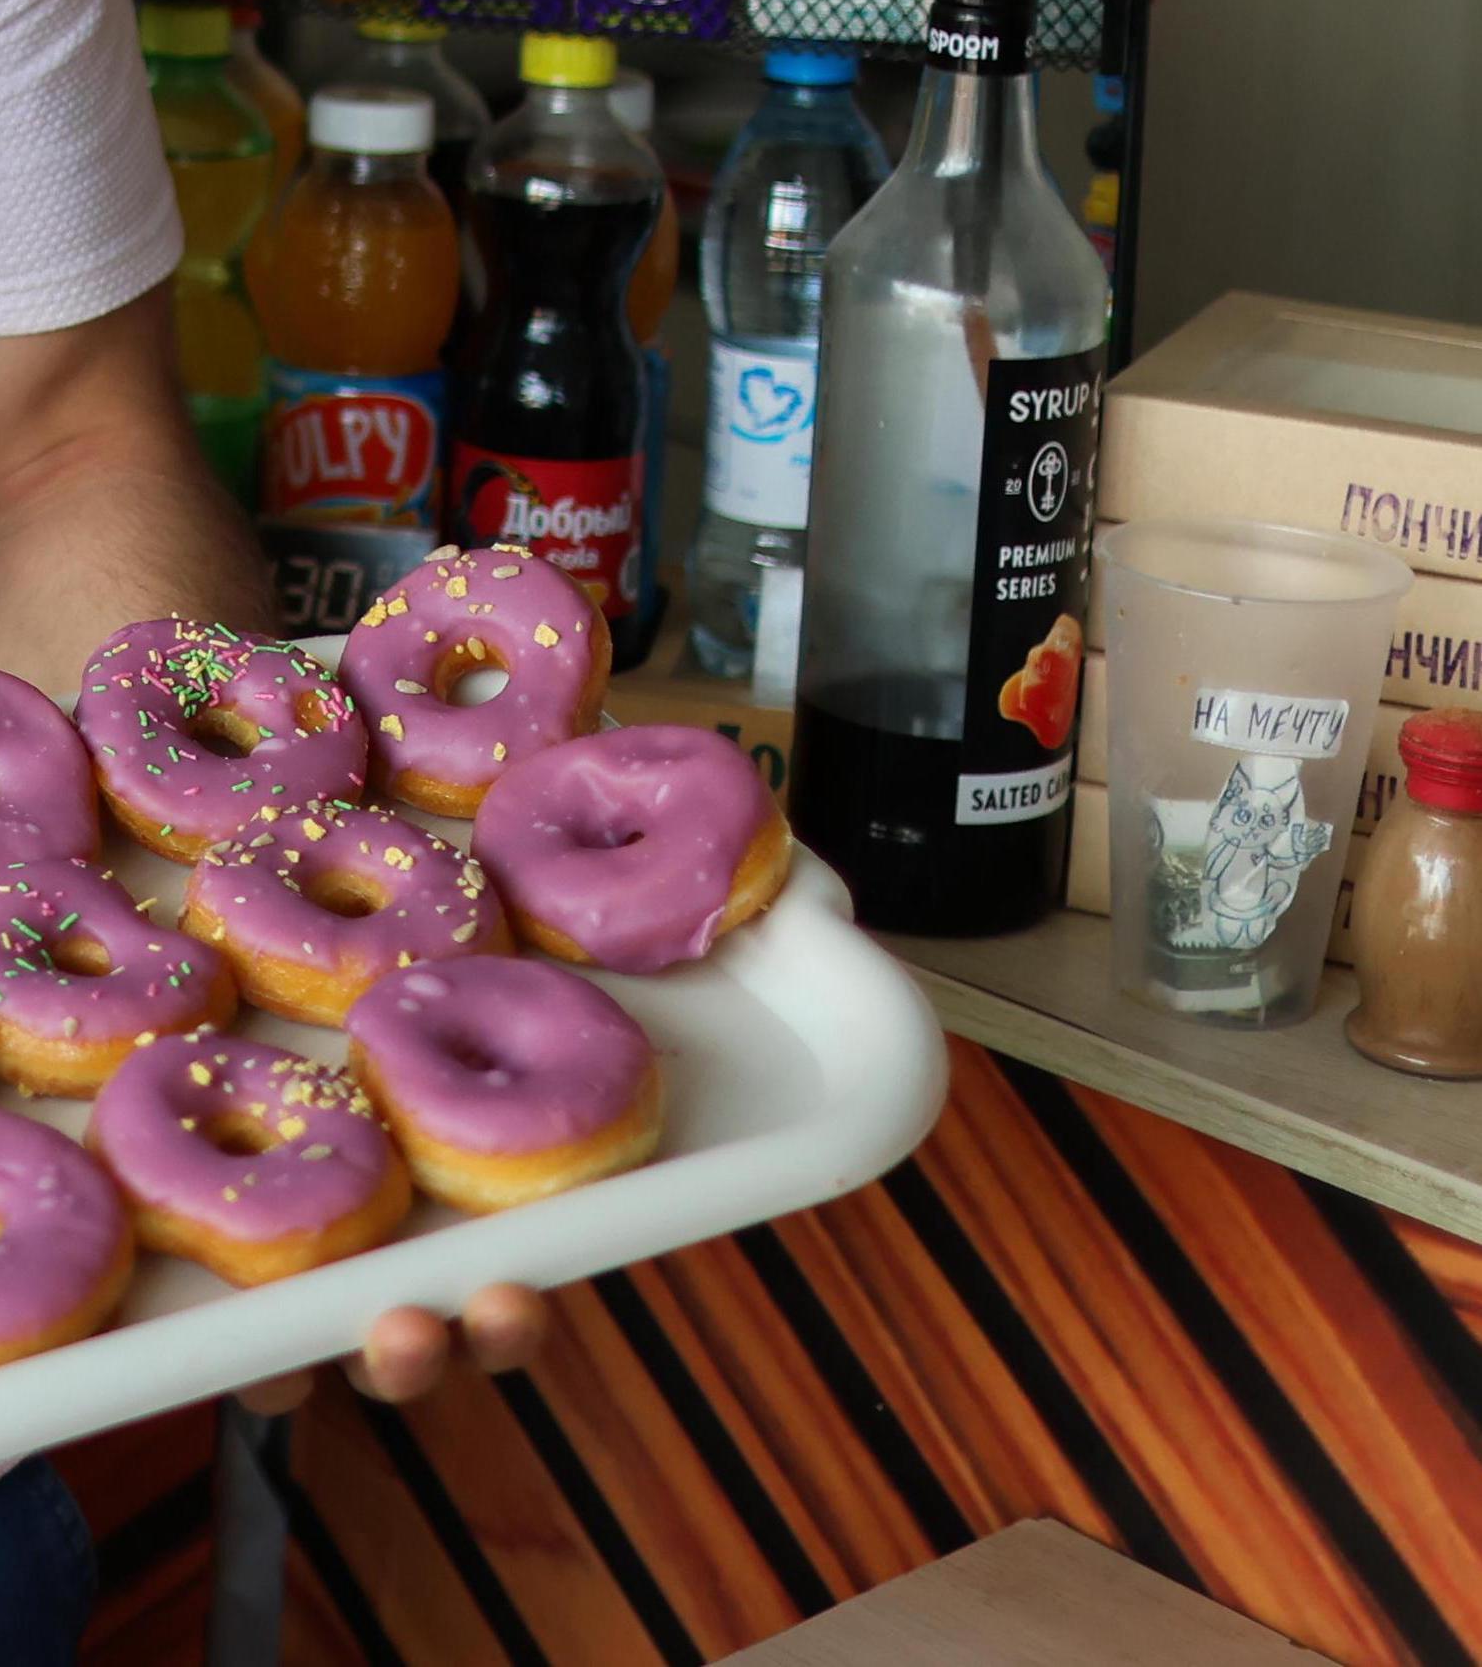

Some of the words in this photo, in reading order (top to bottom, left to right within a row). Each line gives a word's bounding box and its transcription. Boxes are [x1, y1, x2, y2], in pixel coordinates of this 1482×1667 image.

[1008, 382, 1090, 423] SYRUP
[499, 490, 633, 546] Добрый
[998, 537, 1076, 569] PREMIUM
[271, 556, 366, 630] 30
[995, 572, 1057, 602] SERIES
[1193, 695, 1229, 737] НА
[1248, 701, 1345, 751] МЕЧТУ
[971, 782, 1042, 812] SALTED
